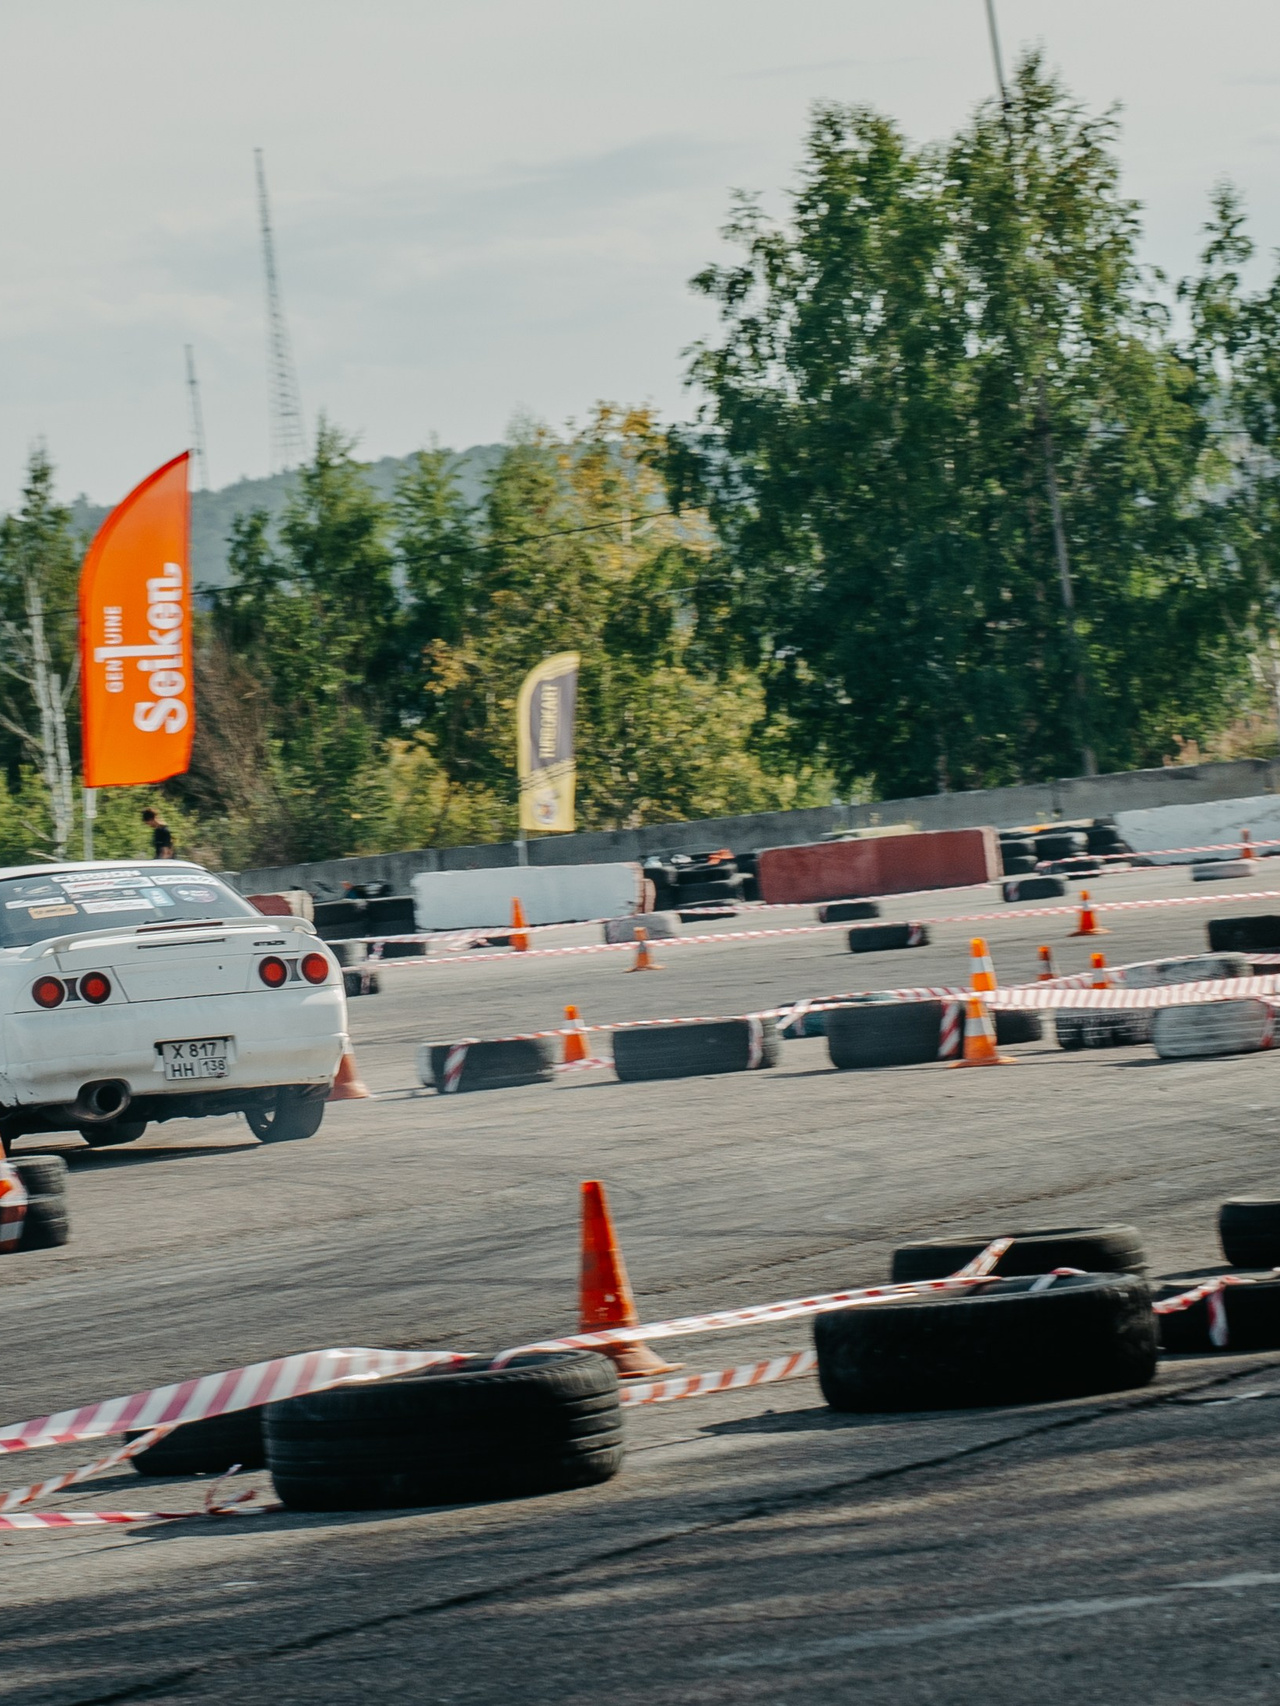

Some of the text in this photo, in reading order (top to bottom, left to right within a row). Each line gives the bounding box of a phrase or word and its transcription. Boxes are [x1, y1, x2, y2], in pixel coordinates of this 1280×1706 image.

[94, 562, 188, 735] Seiken
[104, 606, 124, 693] GENUINE
[189, 1042, 217, 1058] 817
[202, 1059, 226, 1072] 138
